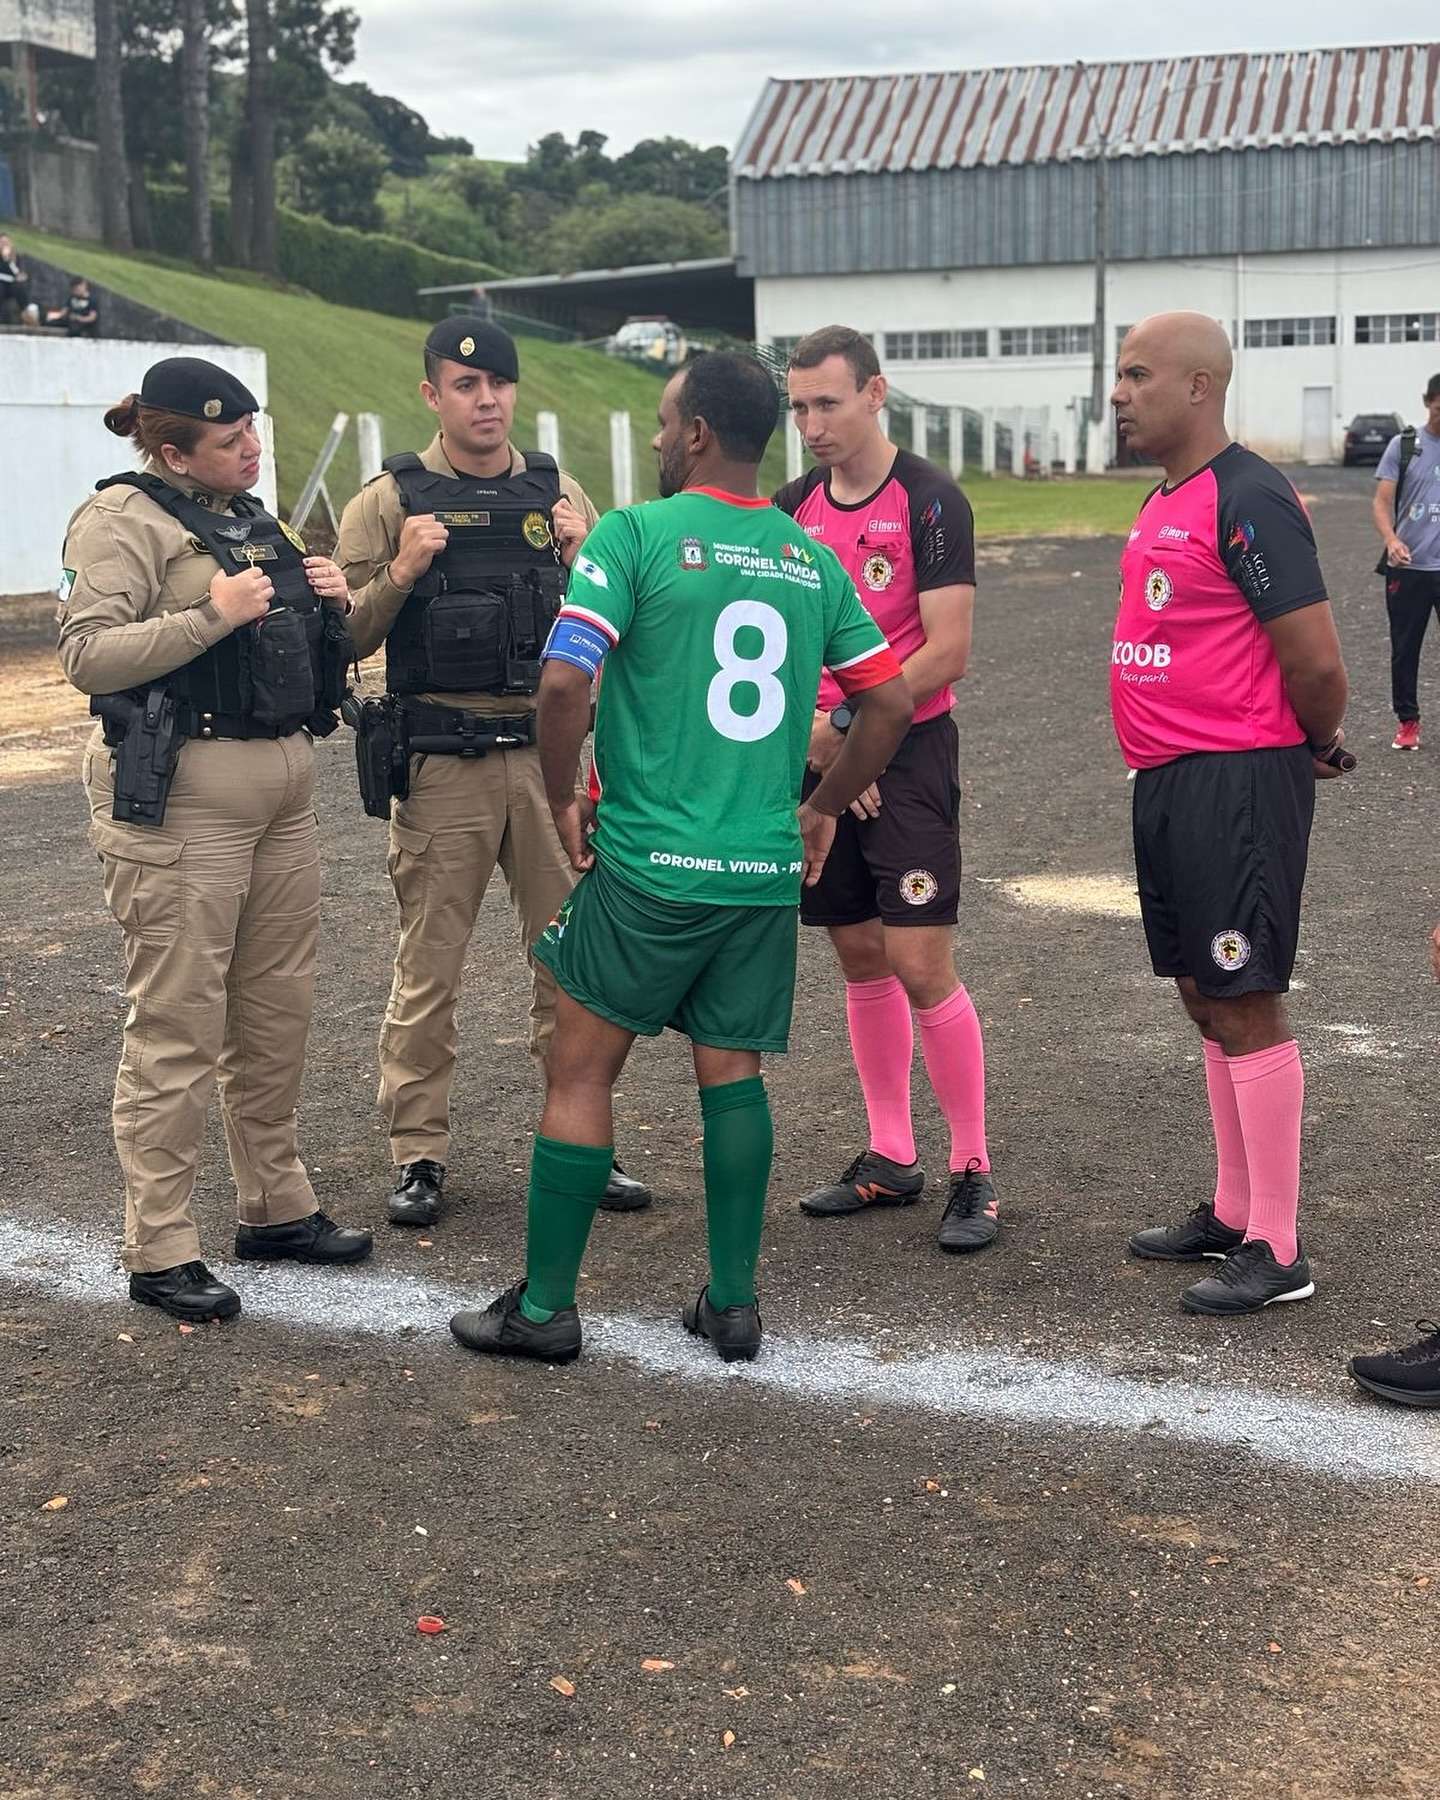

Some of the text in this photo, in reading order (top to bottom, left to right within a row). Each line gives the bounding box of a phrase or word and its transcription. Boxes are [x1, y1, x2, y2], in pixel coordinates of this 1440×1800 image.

[715, 551, 777, 570] CORONEL
[707, 600, 788, 742] 8
[650, 851, 725, 872] CORONEL
[729, 861, 778, 874] VIVIDA
